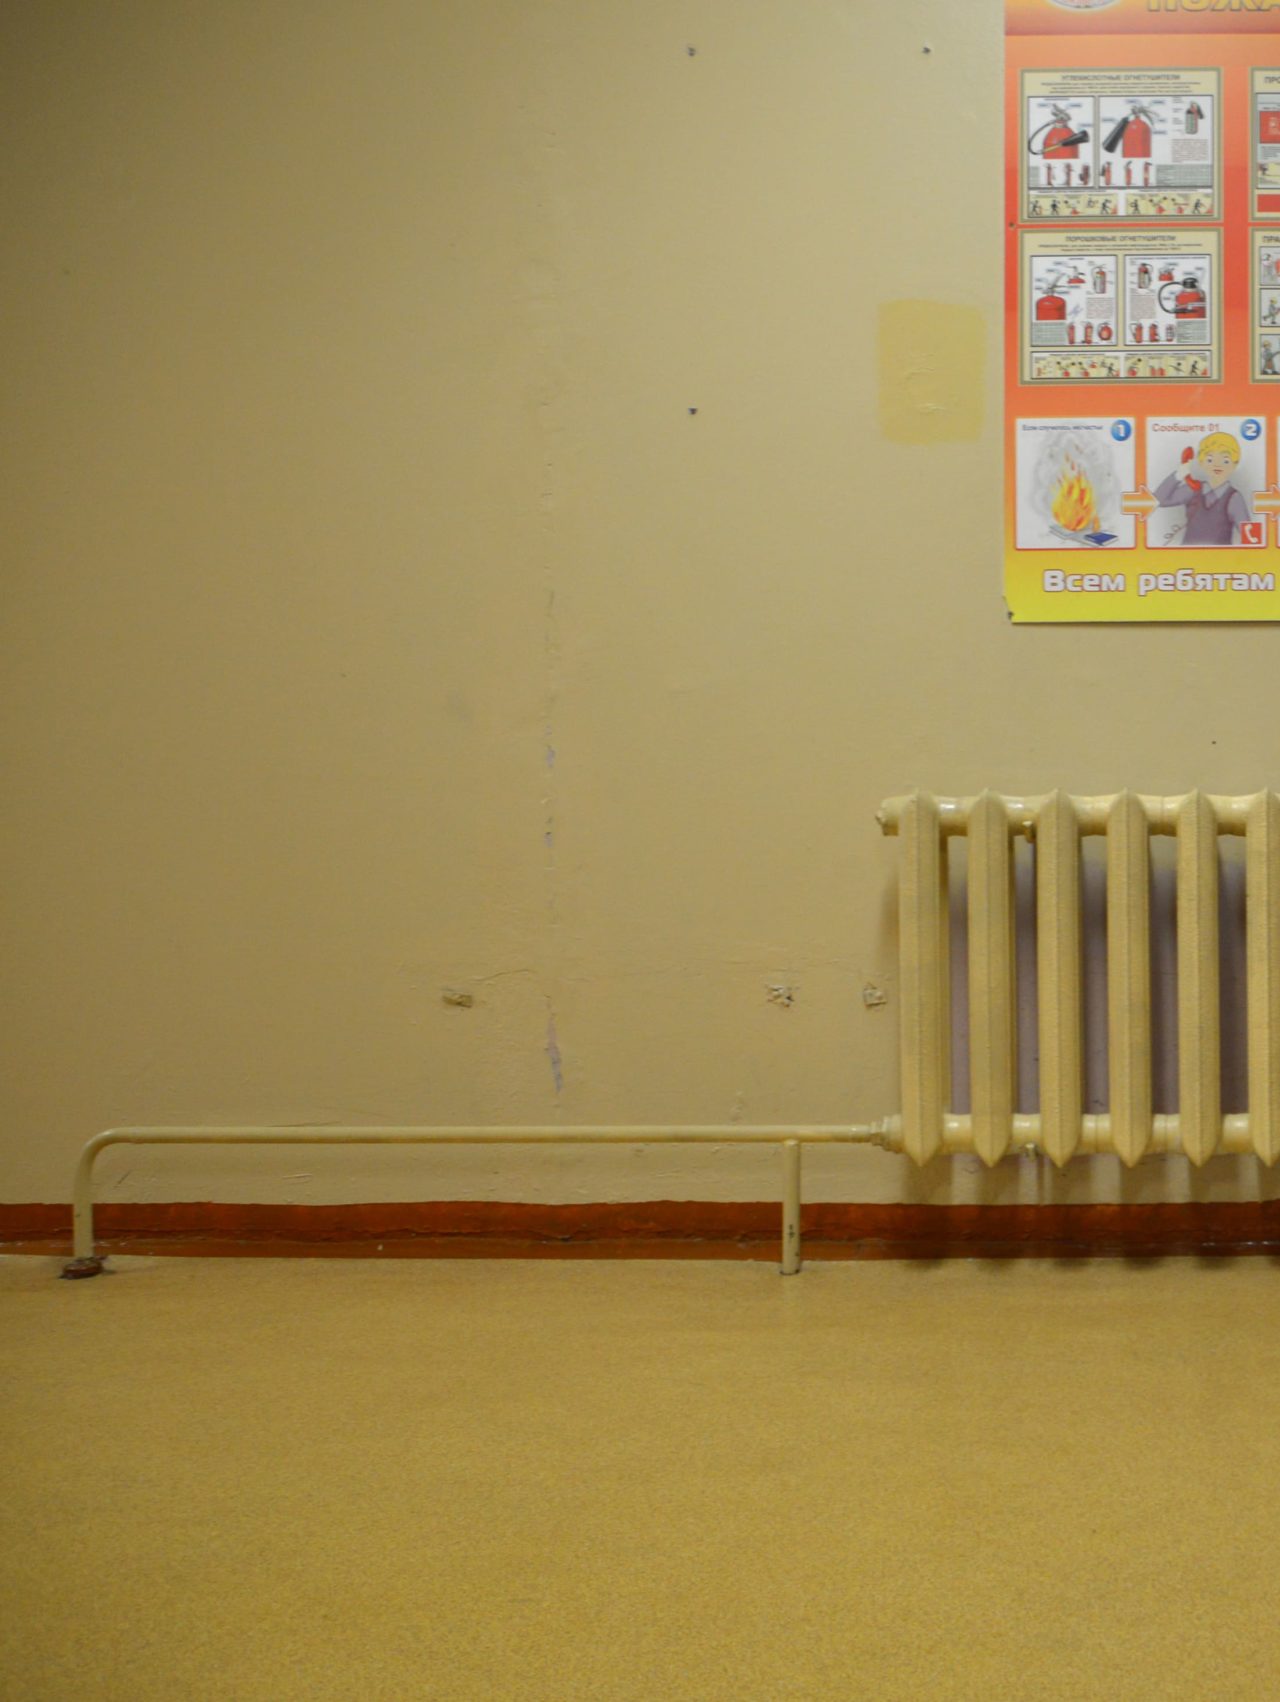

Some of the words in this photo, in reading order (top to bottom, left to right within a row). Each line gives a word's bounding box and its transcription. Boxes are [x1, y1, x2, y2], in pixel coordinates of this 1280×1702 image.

[1152, 423, 1206, 434] Сообщите
[1208, 423, 1220, 432] 01
[1246, 423, 1257, 436] 2
[1043, 569, 1125, 592] Всем
[1137, 568, 1274, 597] ребятам
